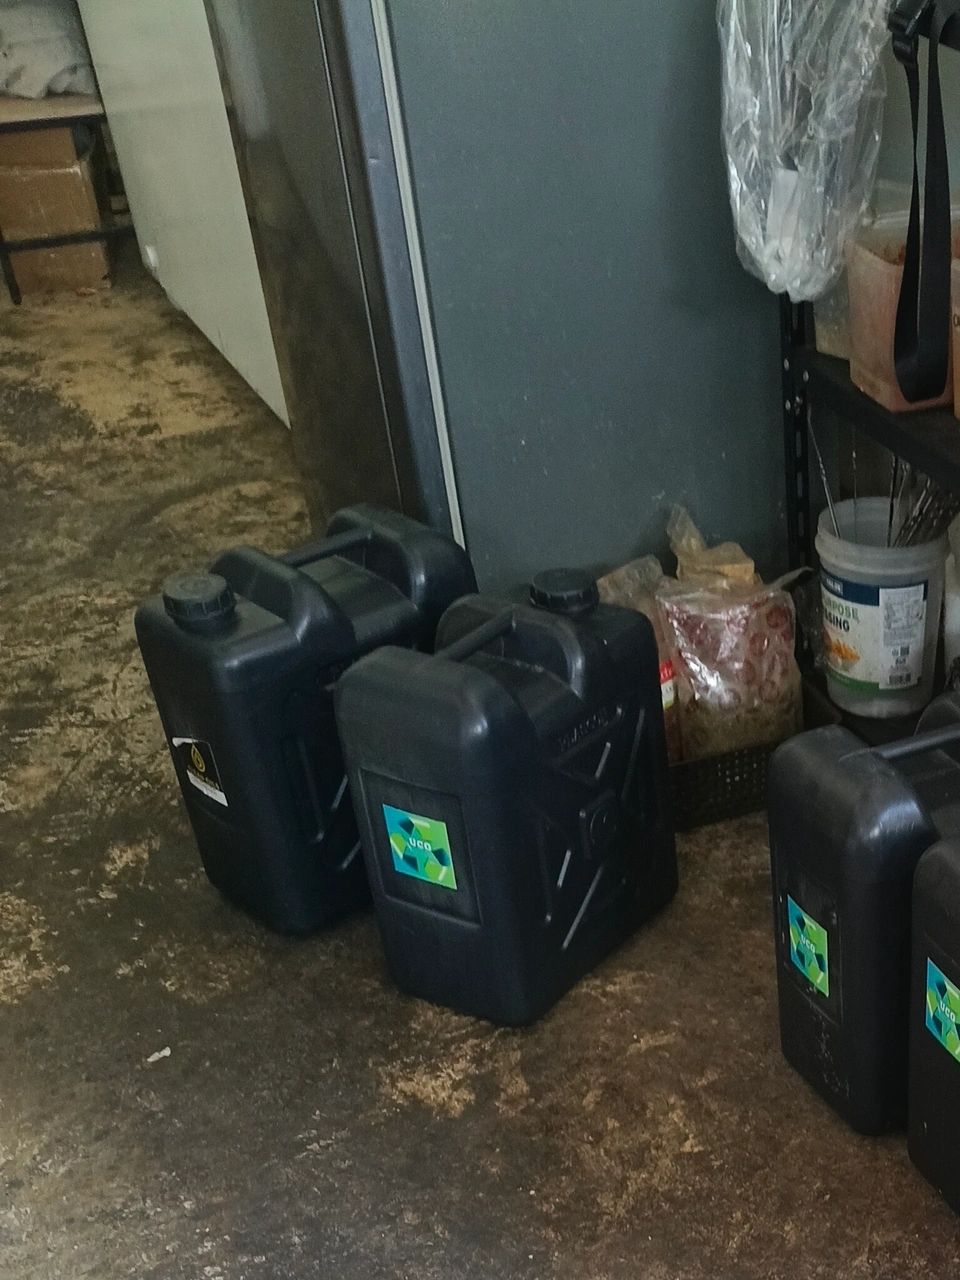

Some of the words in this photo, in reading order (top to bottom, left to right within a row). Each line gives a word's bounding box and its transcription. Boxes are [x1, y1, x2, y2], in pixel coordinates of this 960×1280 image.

[409, 837, 432, 852] UCO
[801, 934, 816, 954] UCO
[940, 1001, 956, 1022] UCO
